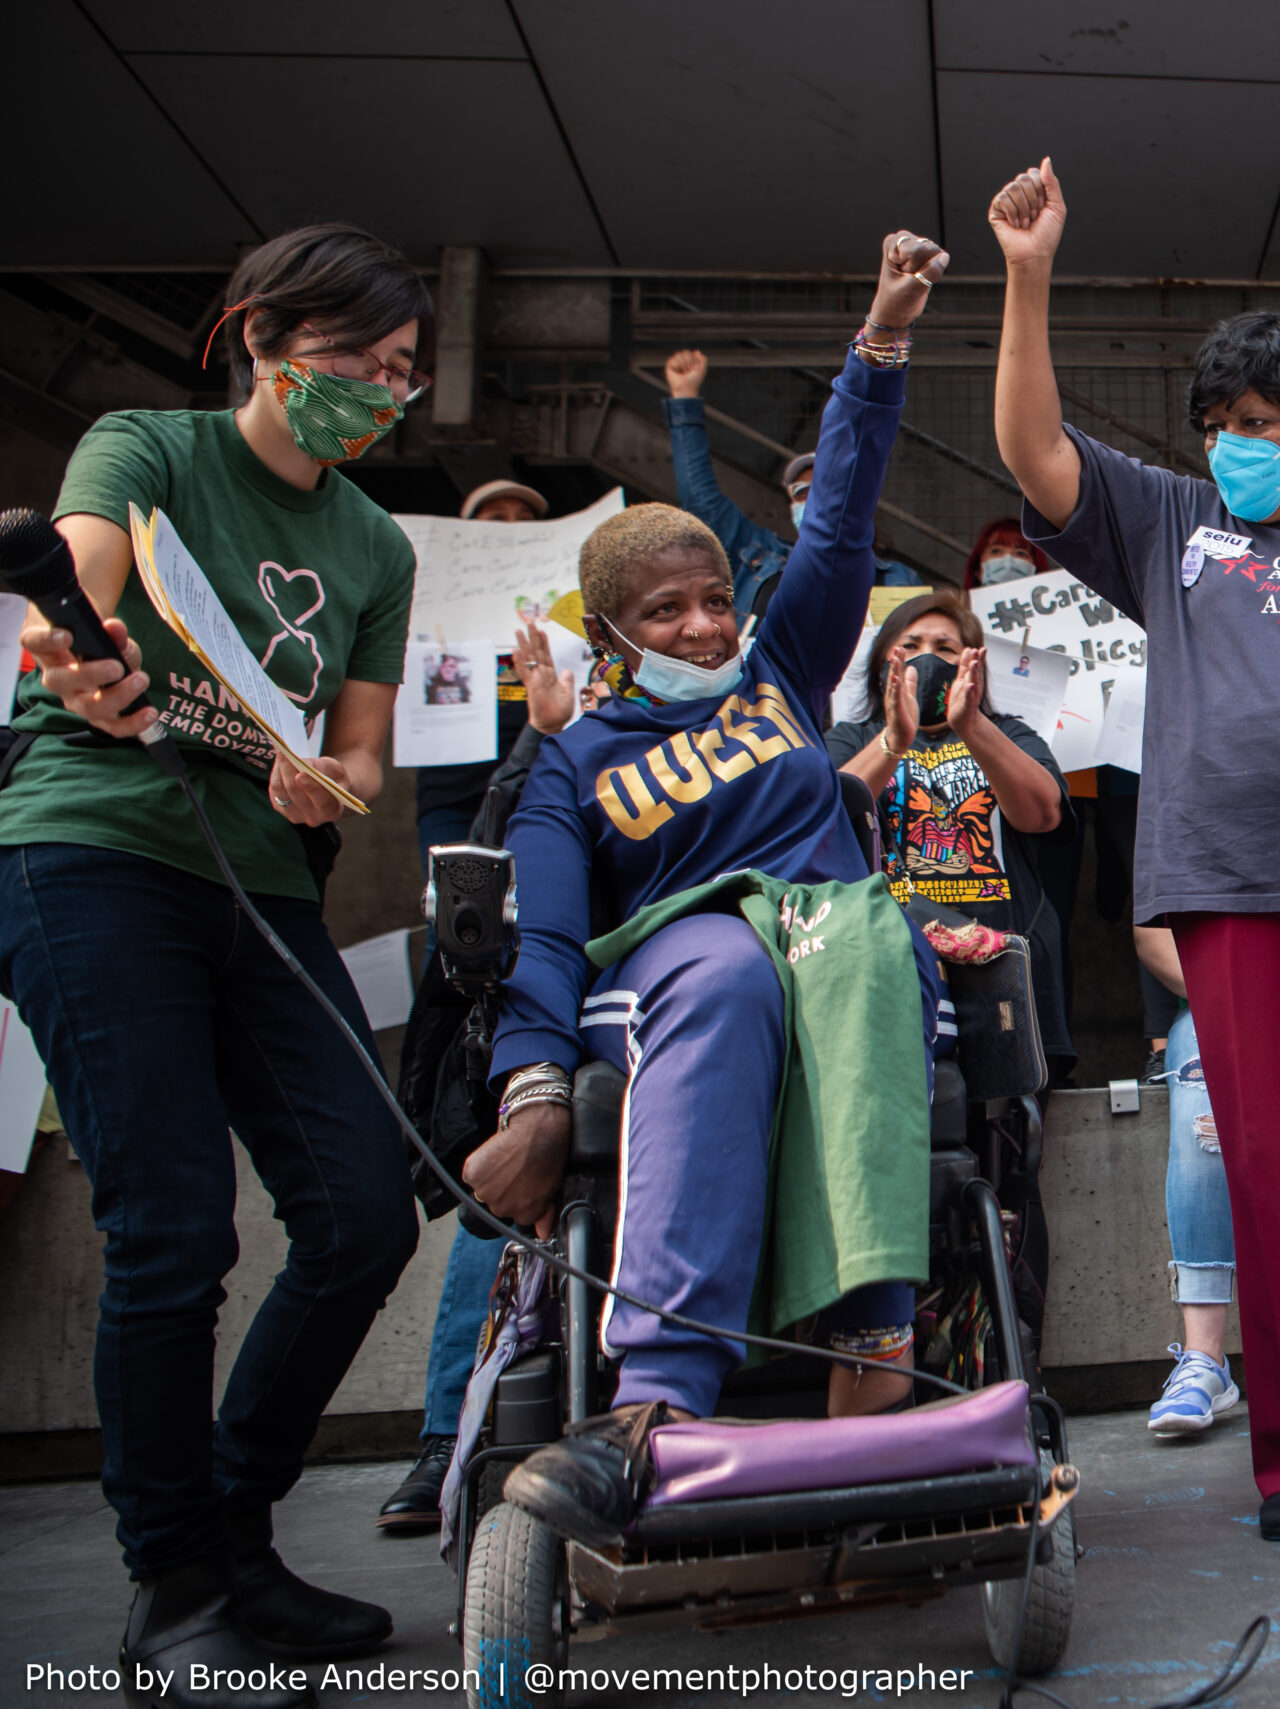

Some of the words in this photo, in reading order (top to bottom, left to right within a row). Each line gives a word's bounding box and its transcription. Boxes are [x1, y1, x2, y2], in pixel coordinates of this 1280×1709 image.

[1203, 531, 1243, 546] seiu
[169, 672, 251, 718] HAN
[169, 695, 208, 720] THE
[158, 710, 277, 760] EMPLOYERS
[596, 683, 816, 841] QUEEN
[787, 935, 826, 965] ORK
